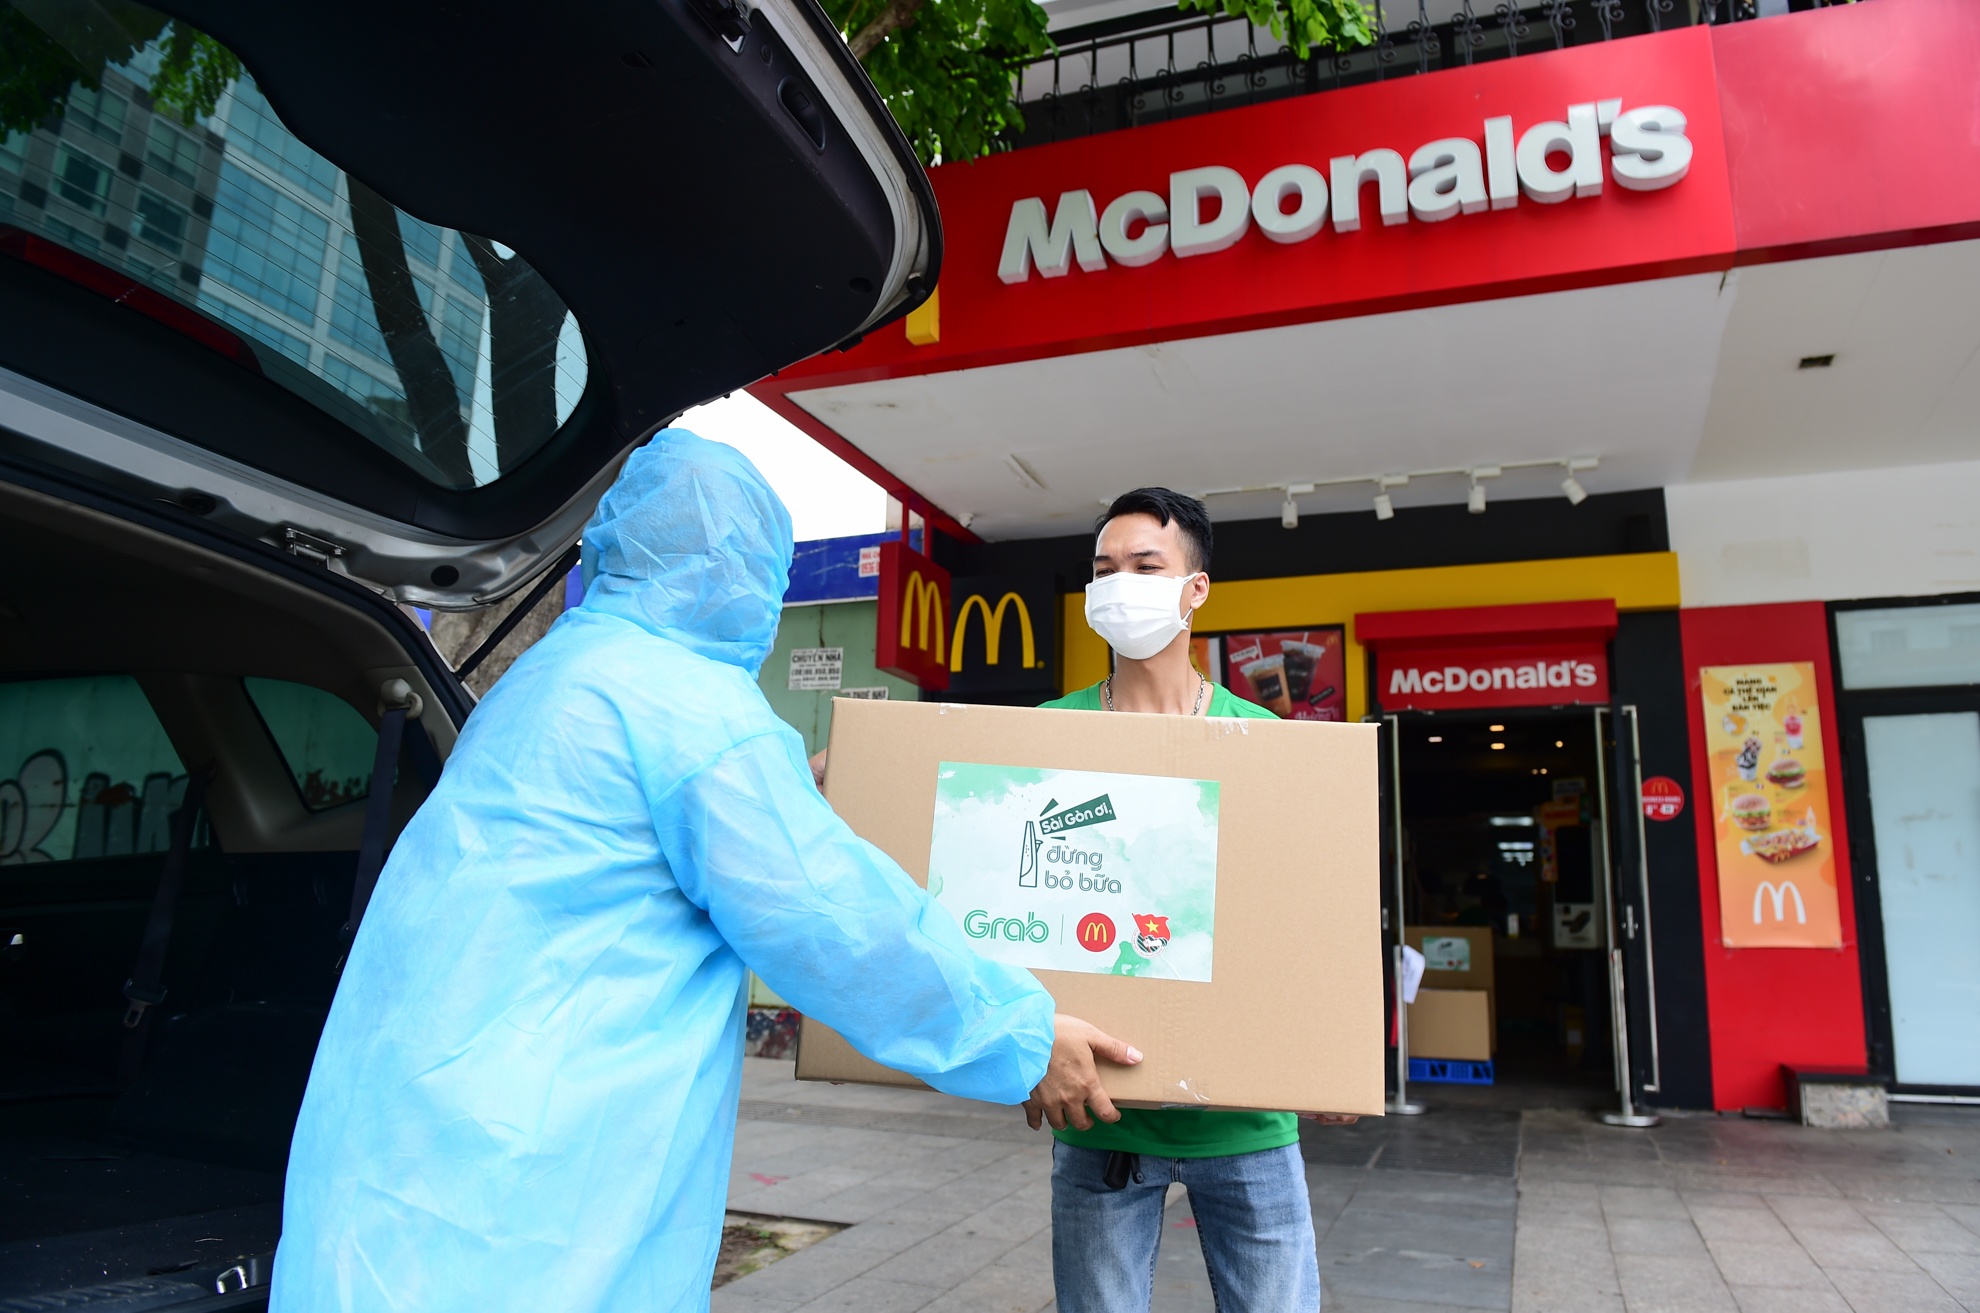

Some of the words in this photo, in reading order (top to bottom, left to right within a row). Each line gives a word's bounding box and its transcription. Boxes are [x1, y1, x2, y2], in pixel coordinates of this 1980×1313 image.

[998, 97, 1693, 285] McDonald's
[1389, 660, 1598, 695] McDonald's
[1041, 816, 1064, 834] Sài
[1064, 809, 1094, 826] Gòn
[1046, 844, 1103, 871] đừng
[1044, 869, 1074, 890] bỏ
[1078, 872, 1122, 894] bữa
[963, 909, 1050, 944] Grab
